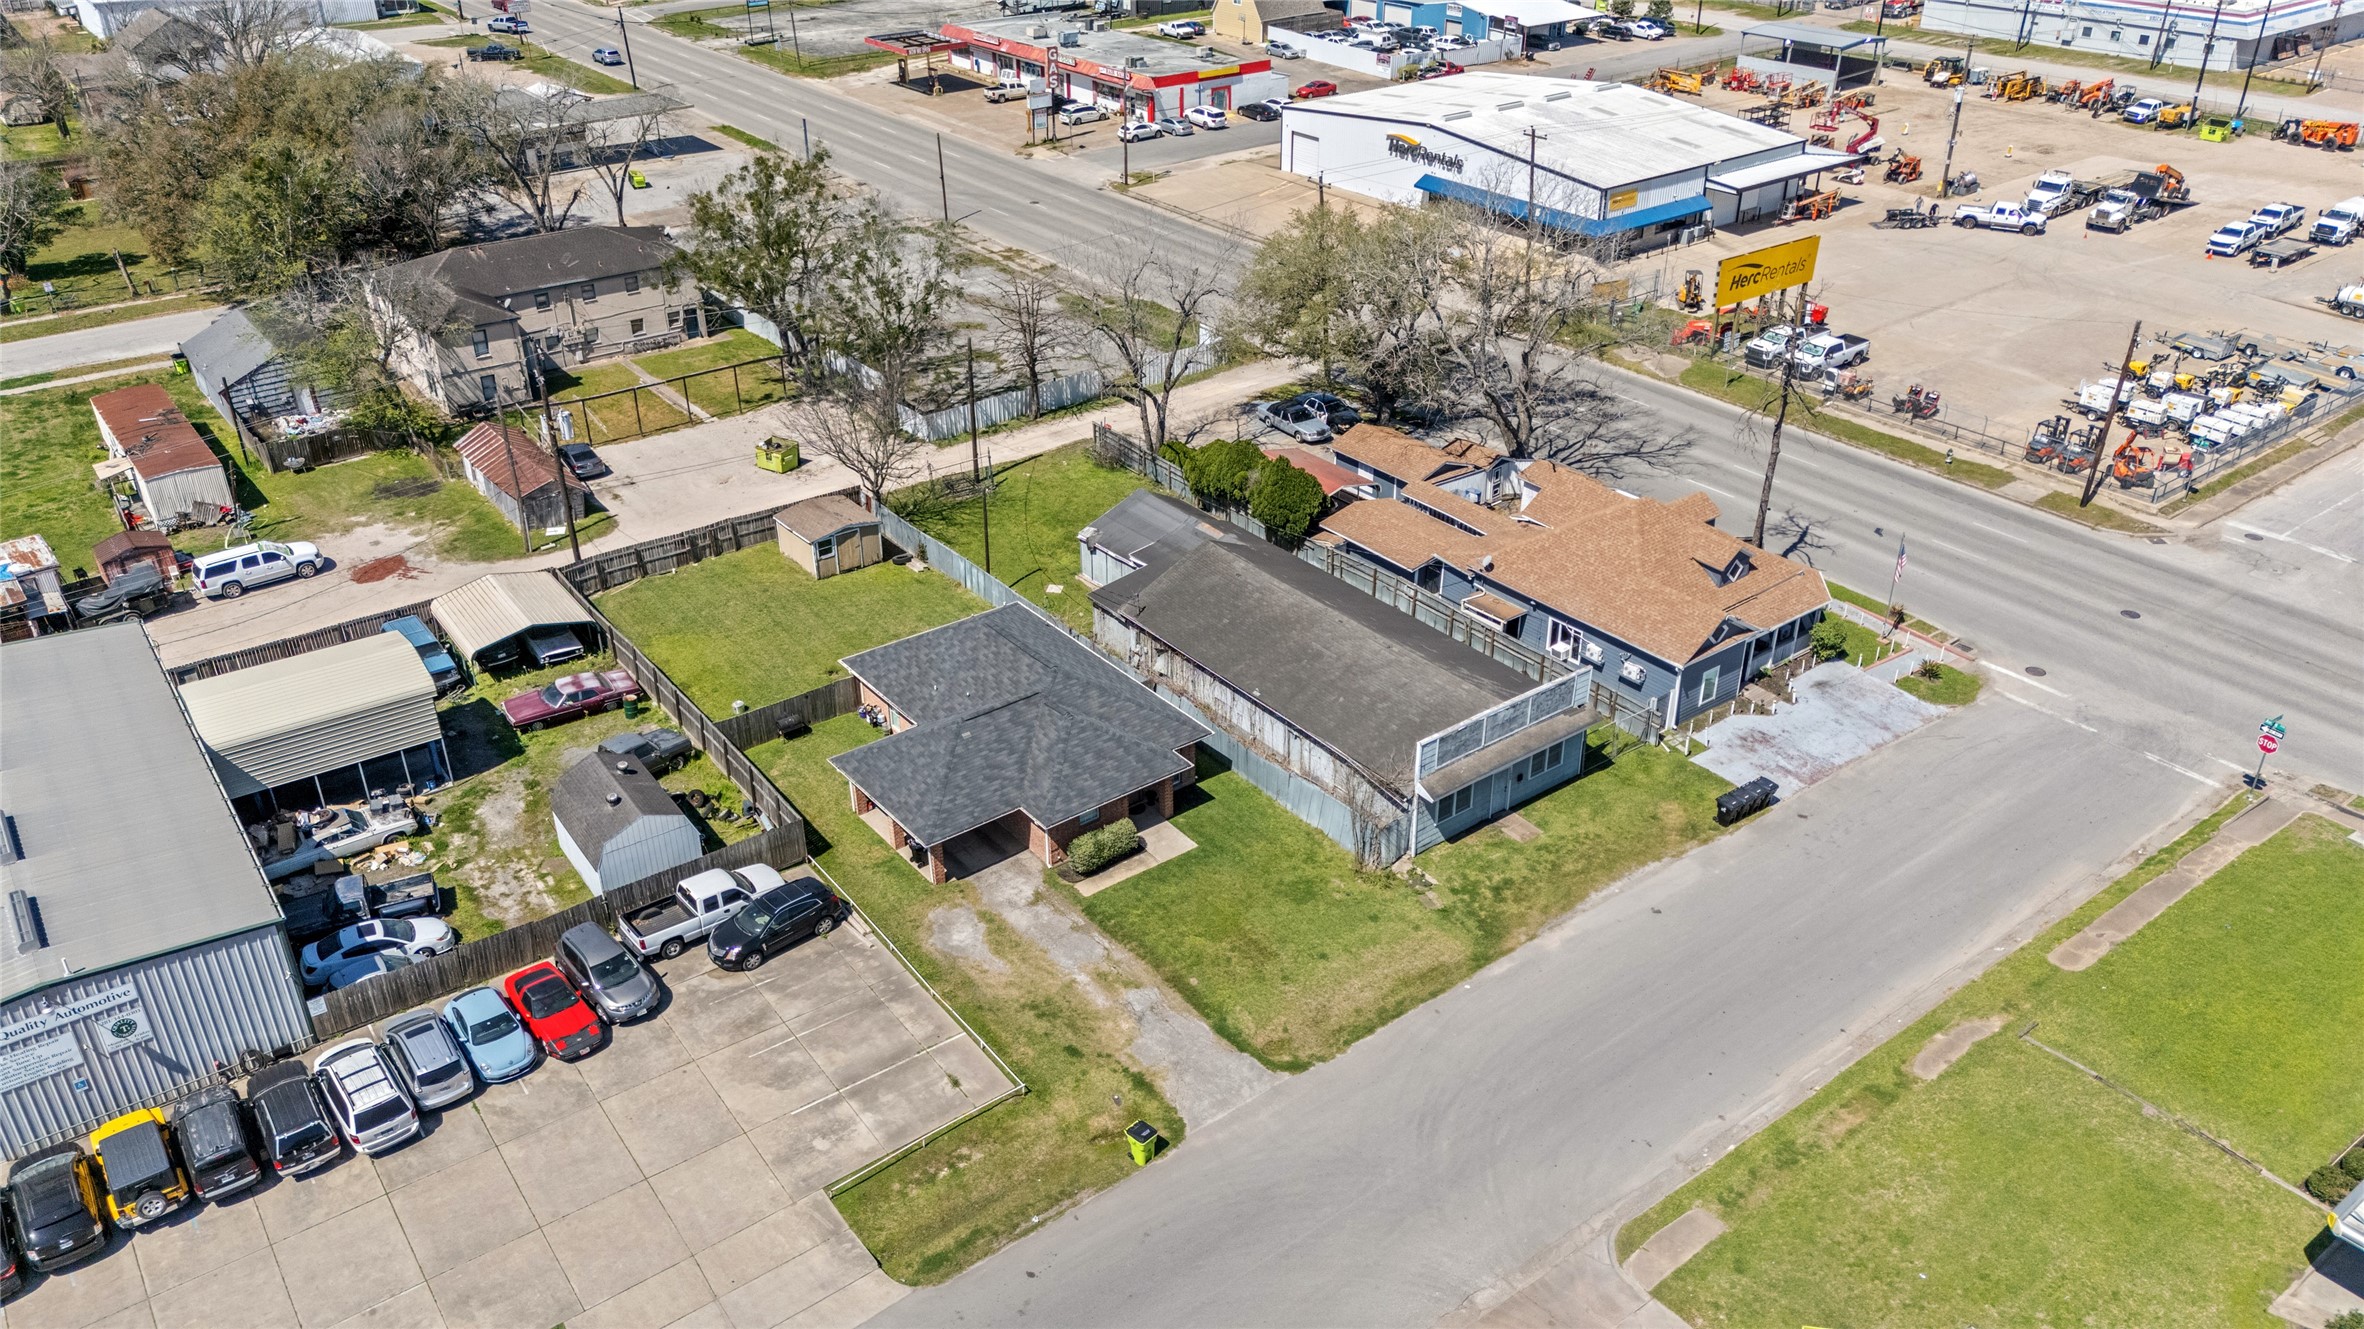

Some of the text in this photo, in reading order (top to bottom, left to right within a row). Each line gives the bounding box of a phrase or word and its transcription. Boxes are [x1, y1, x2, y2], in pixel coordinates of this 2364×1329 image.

[1048, 49, 1058, 88] GAS
[1729, 257, 1807, 291] HercRentals
[2259, 738, 2278, 750] STOP
[0, 989, 131, 1040] Quality Automotive
[0, 1071, 22, 1082] adiator
[0, 1076, 23, 1087] ustom
